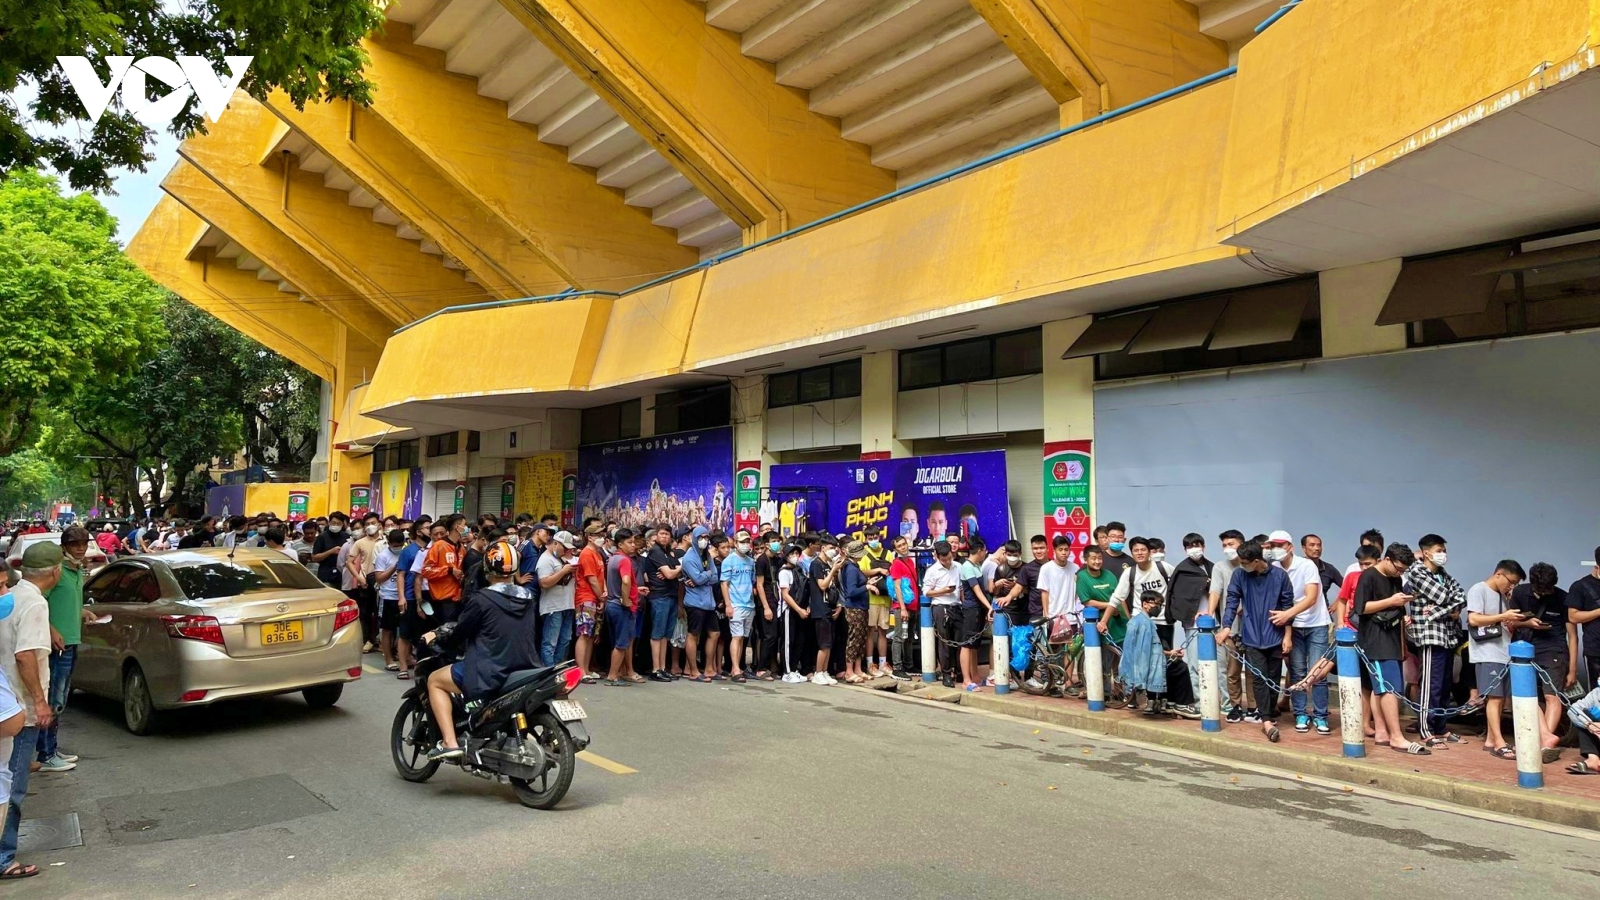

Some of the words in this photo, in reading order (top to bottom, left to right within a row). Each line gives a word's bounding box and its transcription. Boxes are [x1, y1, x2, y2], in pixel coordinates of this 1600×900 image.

[914, 466, 963, 484] JOGARBOLA
[923, 485, 942, 494] OFFICIAL
[942, 484, 957, 494] STORE
[1069, 486, 1086, 496] WOLF
[847, 490, 894, 513] CHINH
[845, 507, 889, 528] PHỤC
[1141, 579, 1162, 591] NICE
[266, 631, 299, 643] 836.66
